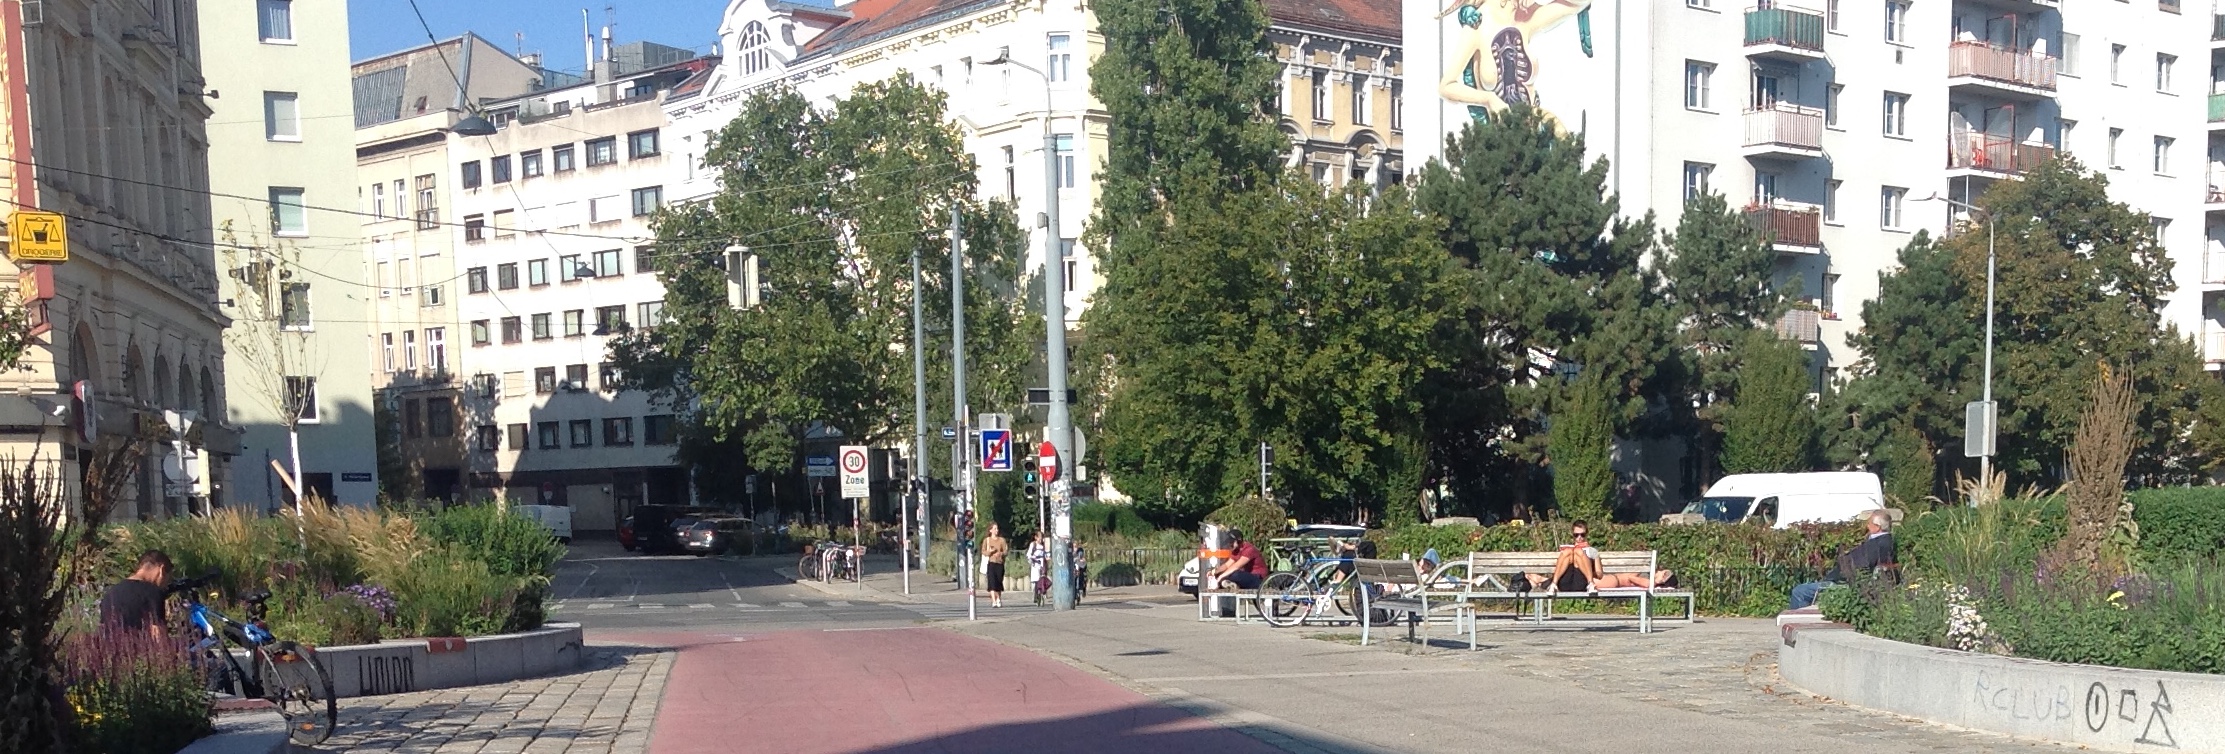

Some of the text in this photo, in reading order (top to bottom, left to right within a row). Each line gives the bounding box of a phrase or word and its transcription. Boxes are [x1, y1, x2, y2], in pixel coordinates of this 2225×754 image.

[22, 248, 62, 256] DROGERIE
[849, 456, 860, 467] 30
[845, 475, 865, 485] Zone
